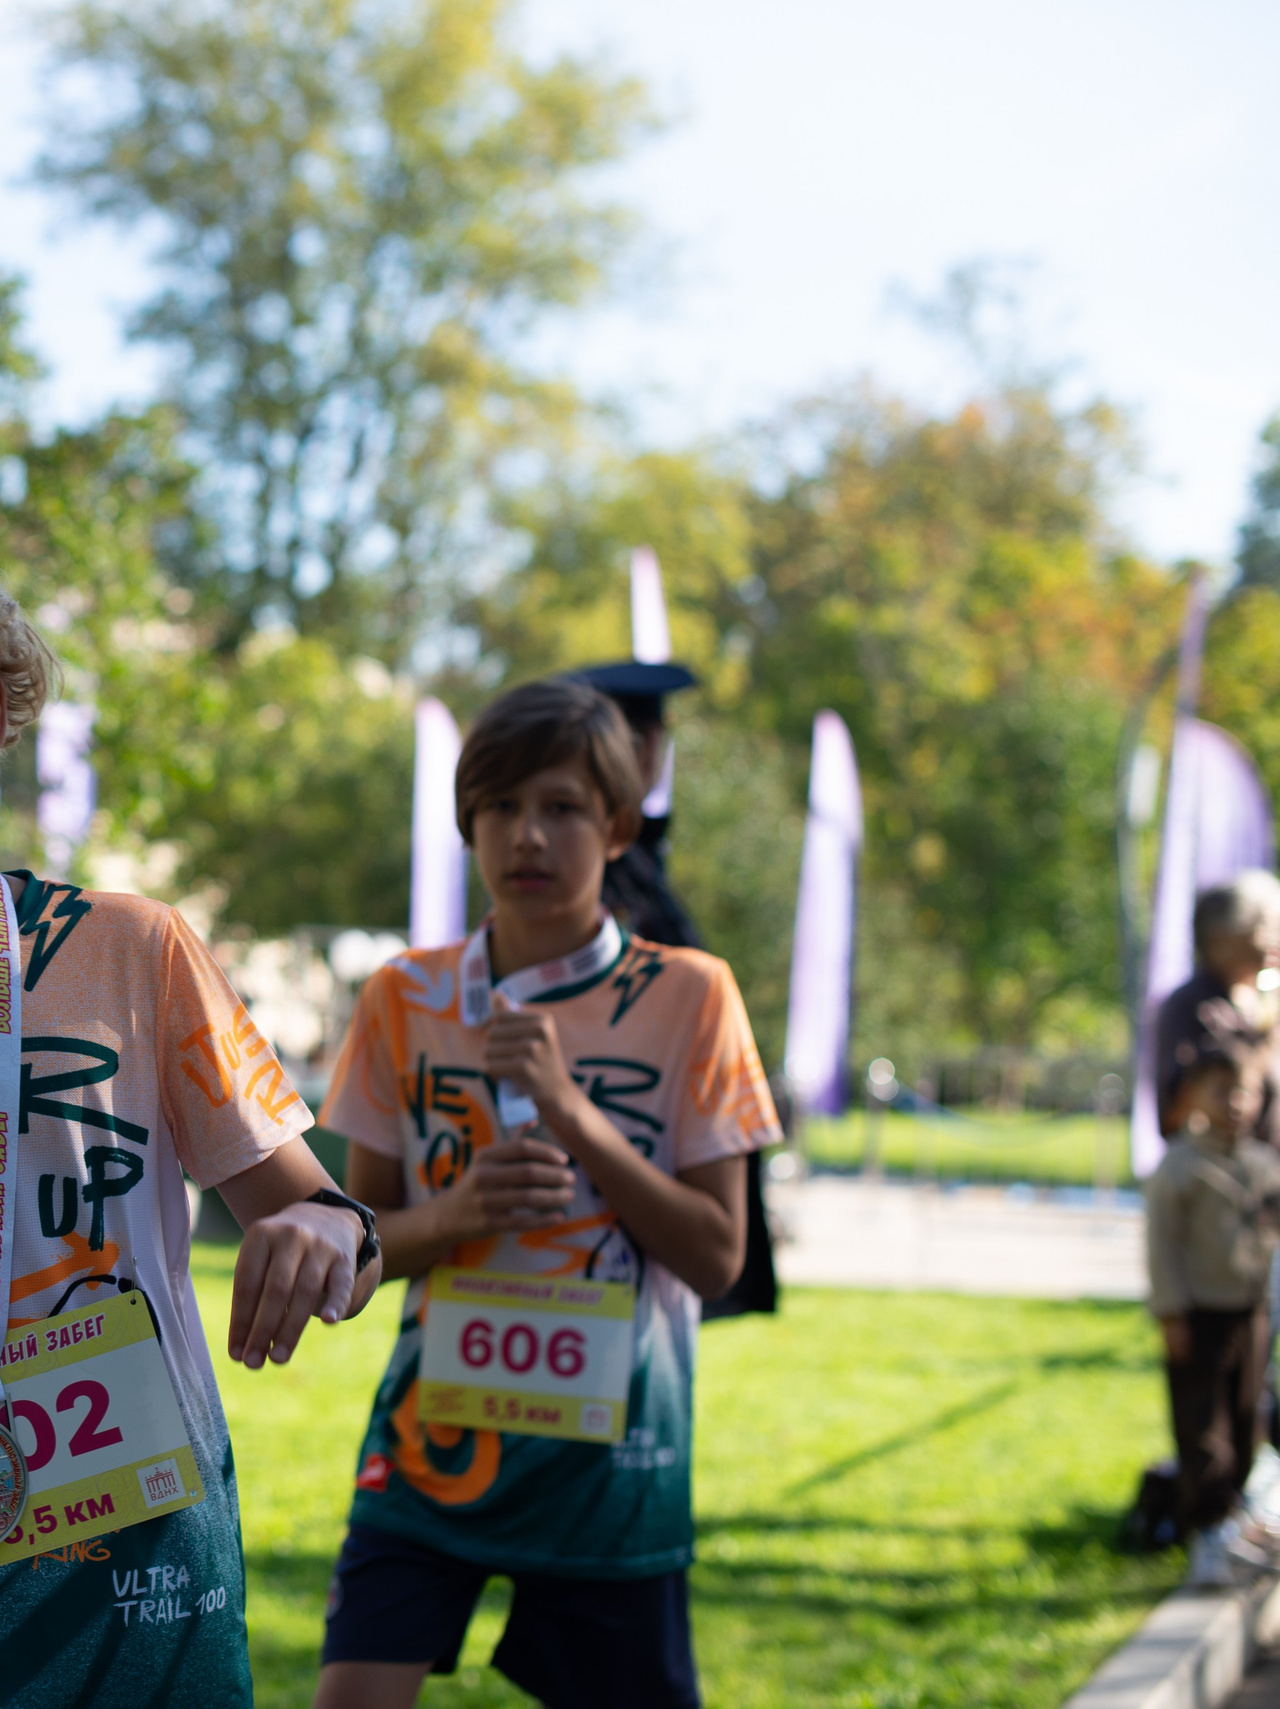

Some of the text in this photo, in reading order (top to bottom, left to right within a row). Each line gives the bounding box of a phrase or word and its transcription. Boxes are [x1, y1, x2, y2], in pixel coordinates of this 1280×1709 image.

[38, 1145, 144, 1251] UP
[44, 1313, 106, 1352] ЗАБЕГ
[459, 1317, 587, 1379] 606
[150, 1486, 179, 1502] ВДНХ
[112, 1565, 191, 1598] ULTRA
[113, 1586, 227, 1627] TRAIL 100
